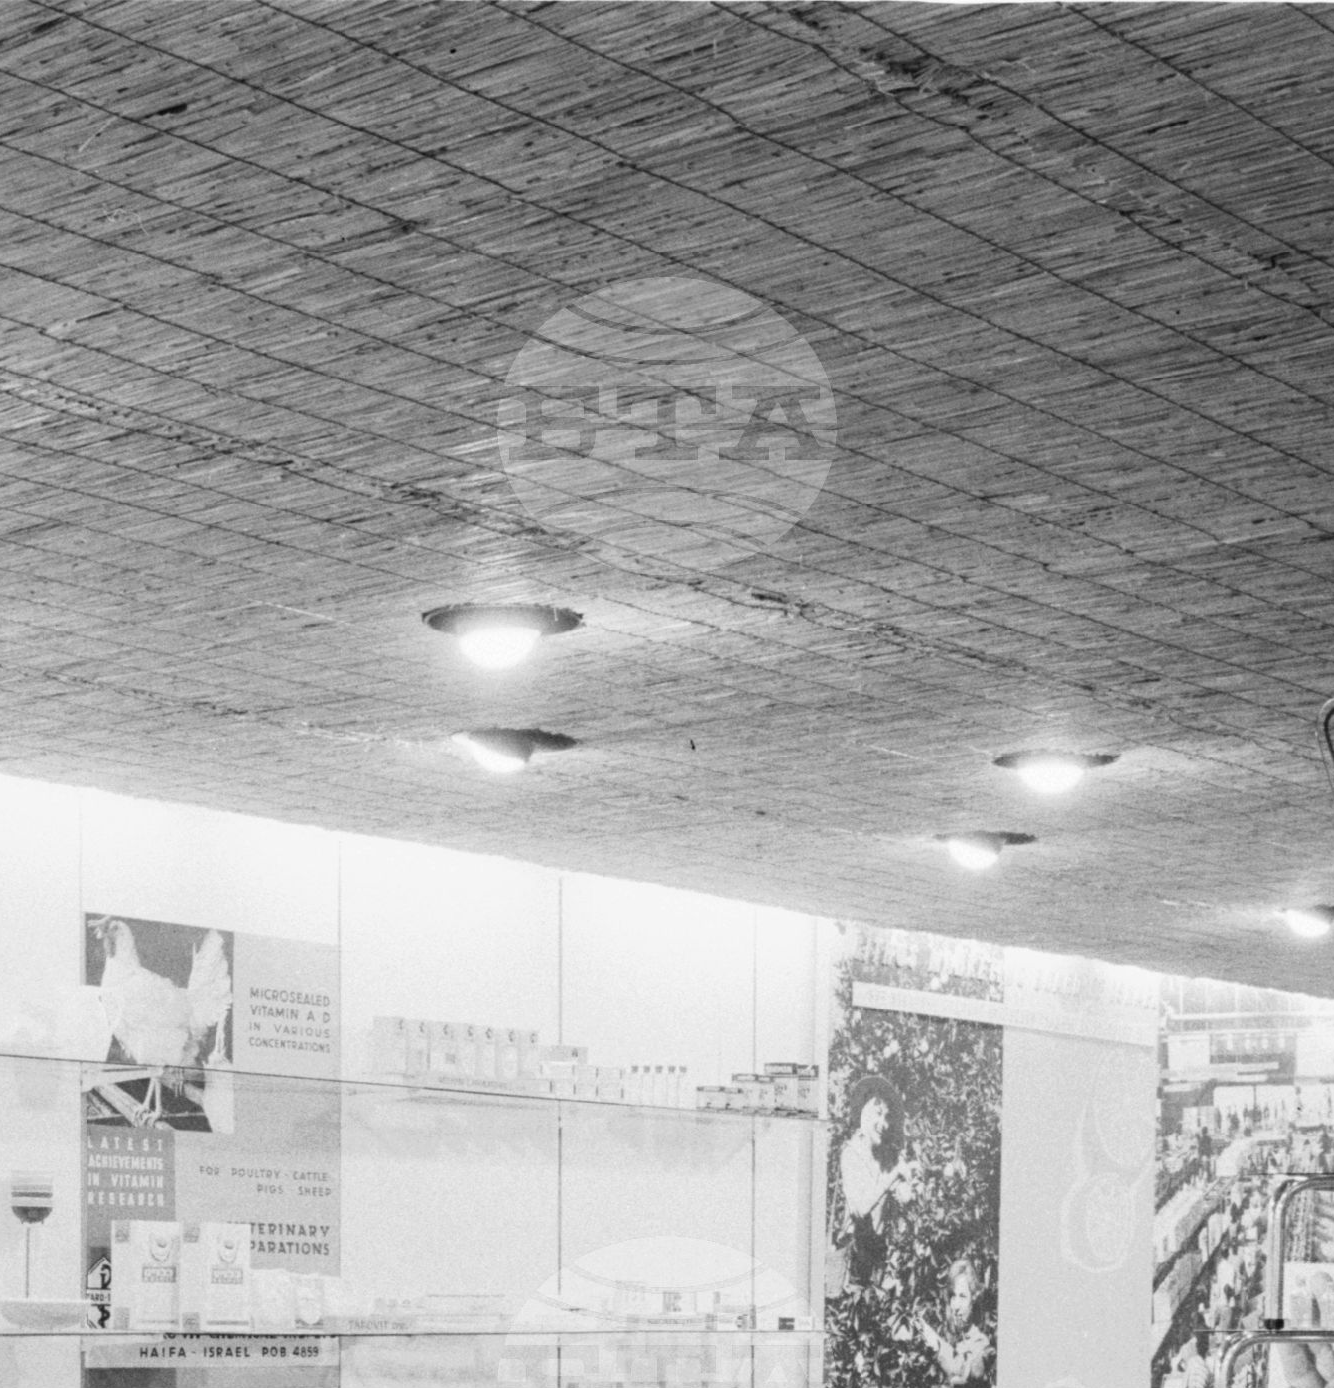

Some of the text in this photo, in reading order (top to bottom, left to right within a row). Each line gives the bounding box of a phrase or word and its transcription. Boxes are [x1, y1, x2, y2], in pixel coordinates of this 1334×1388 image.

[250, 987, 331, 1008] MICROSEALED
[250, 1004, 331, 1024] VITAMIN A D
[249, 1022, 331, 1039] IN VARIOUS
[248, 1036, 331, 1054] CONCENTRATIONS
[87, 1135, 163, 1151] LATEST
[87, 1154, 164, 1170] ACHIEVEMENTS
[87, 1172, 164, 1188] IN VITAMIN
[199, 1166, 329, 1182] FOR POULTRY CATTLE
[256, 1184, 332, 1197] PIGS SHEEP
[250, 1222, 330, 1238] TERINARY
[250, 1240, 330, 1256] PARATIONS
[139, 1345, 320, 1358] HAIFA ISRAEL POB 4859
